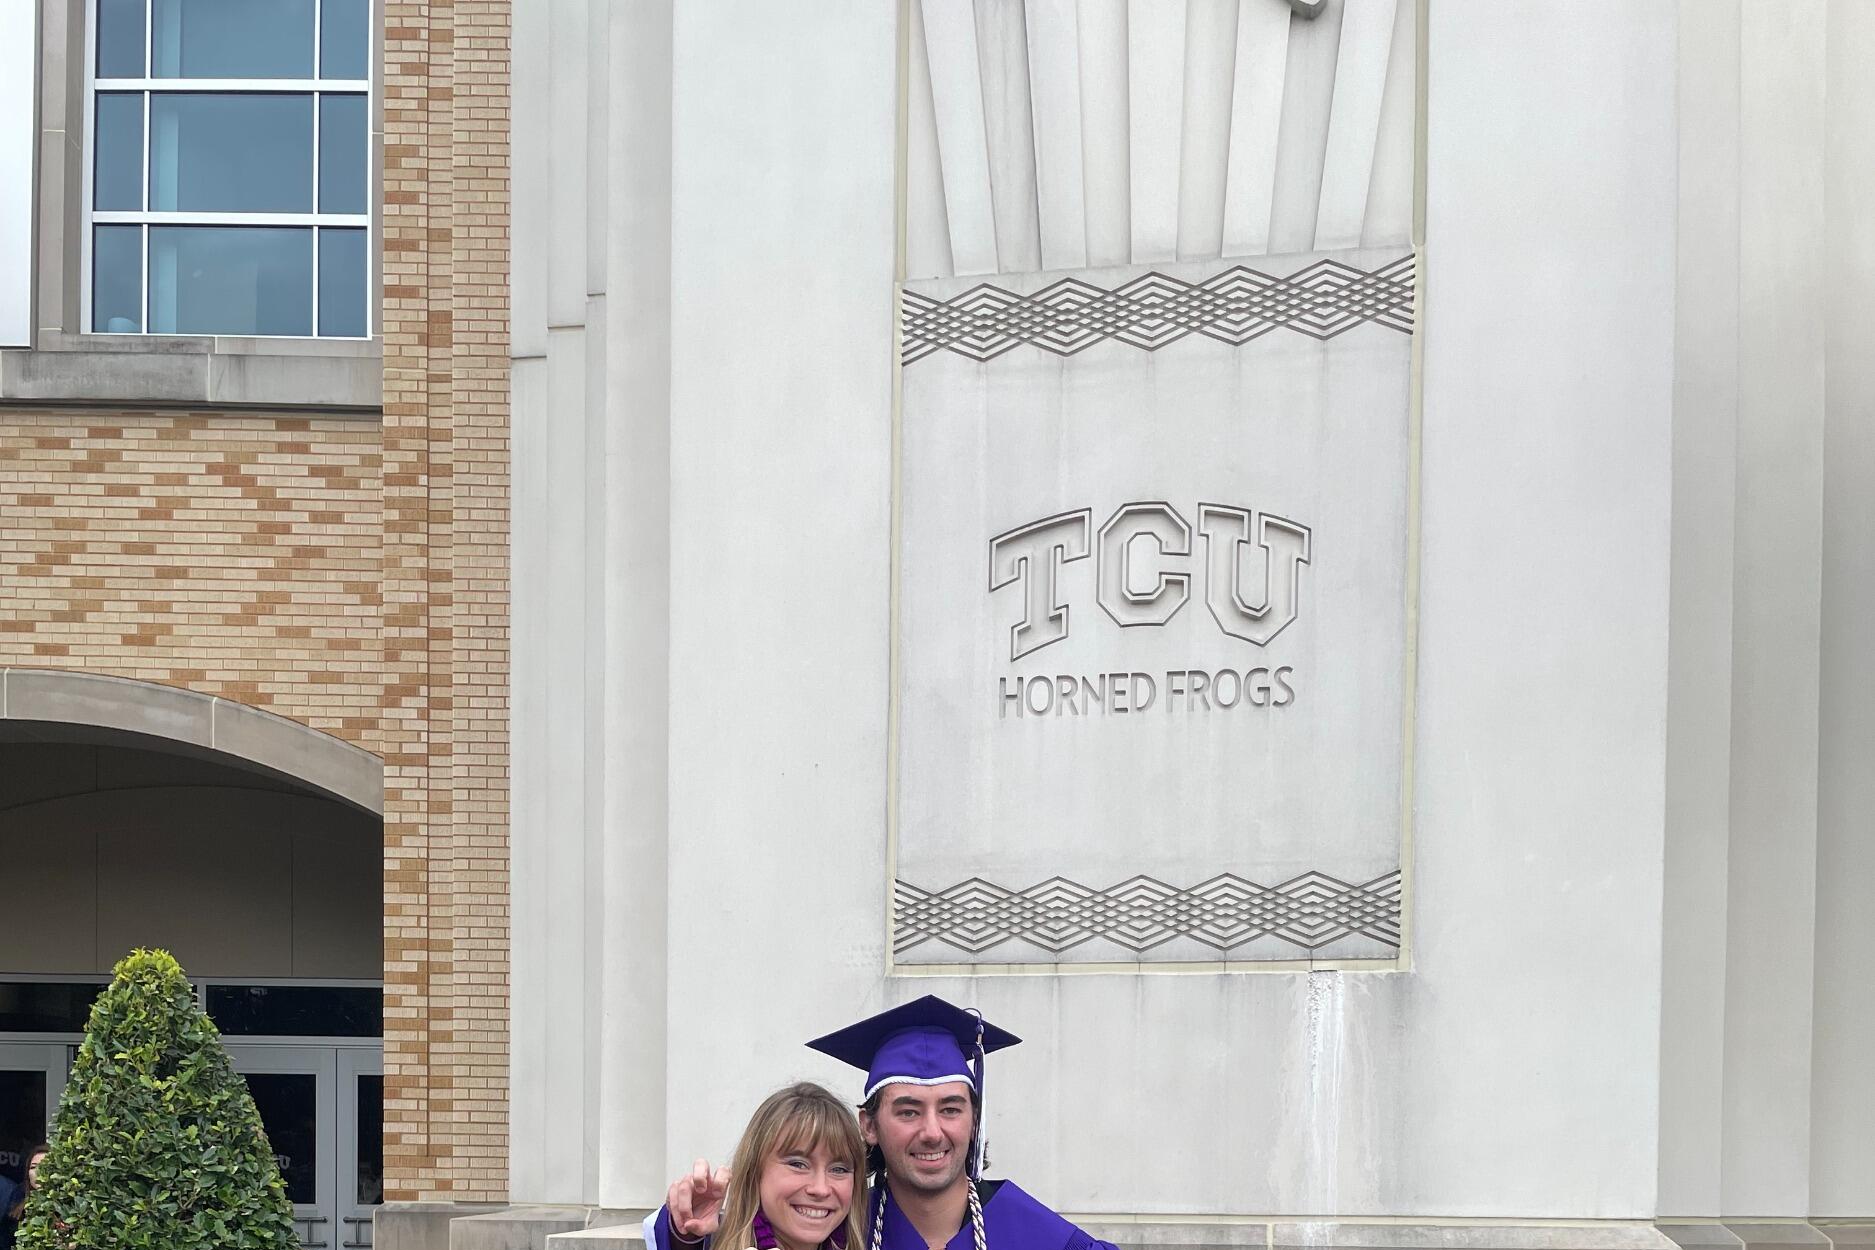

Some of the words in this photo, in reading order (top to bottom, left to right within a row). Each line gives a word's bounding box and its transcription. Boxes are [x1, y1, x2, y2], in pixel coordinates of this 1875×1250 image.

[989, 501, 1311, 662] TCU
[999, 672, 1157, 718] HORNED
[1166, 666, 1296, 713] FROGS
